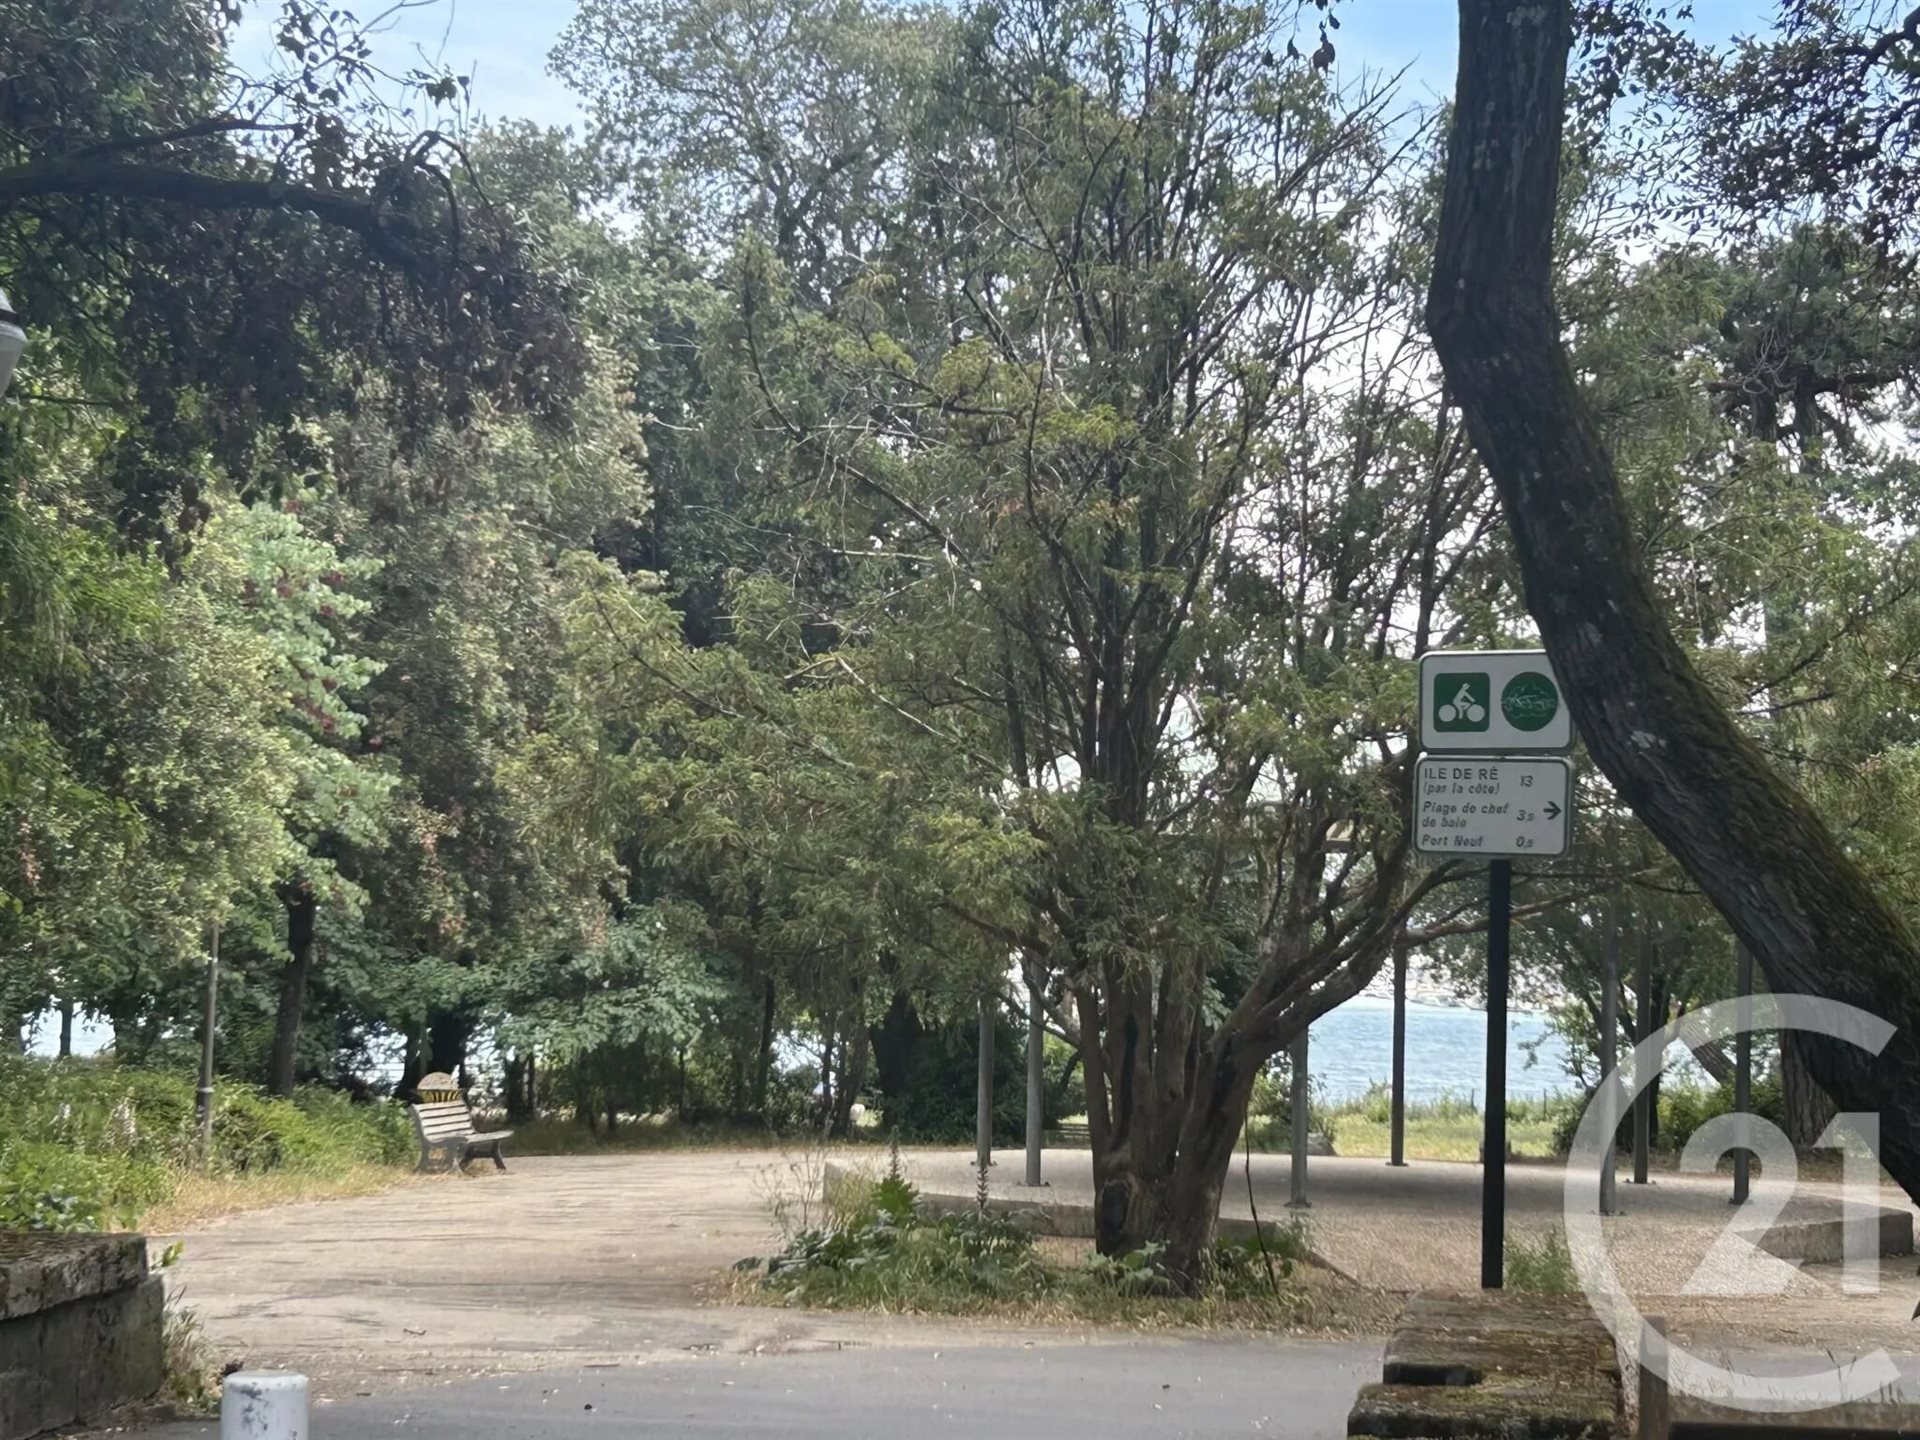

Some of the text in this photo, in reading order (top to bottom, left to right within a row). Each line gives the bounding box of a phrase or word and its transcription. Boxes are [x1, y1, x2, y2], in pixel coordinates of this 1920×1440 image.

[1452, 767, 1473, 780] DE
[1478, 766, 1499, 780] RÉ
[1520, 775, 1534, 787] 13
[1423, 782, 1447, 795] (par
[1452, 782, 1464, 794] la
[1422, 801, 1510, 815] Plage de chef
[1422, 816, 1437, 828] de
[1421, 834, 1484, 847] Port Neuf
